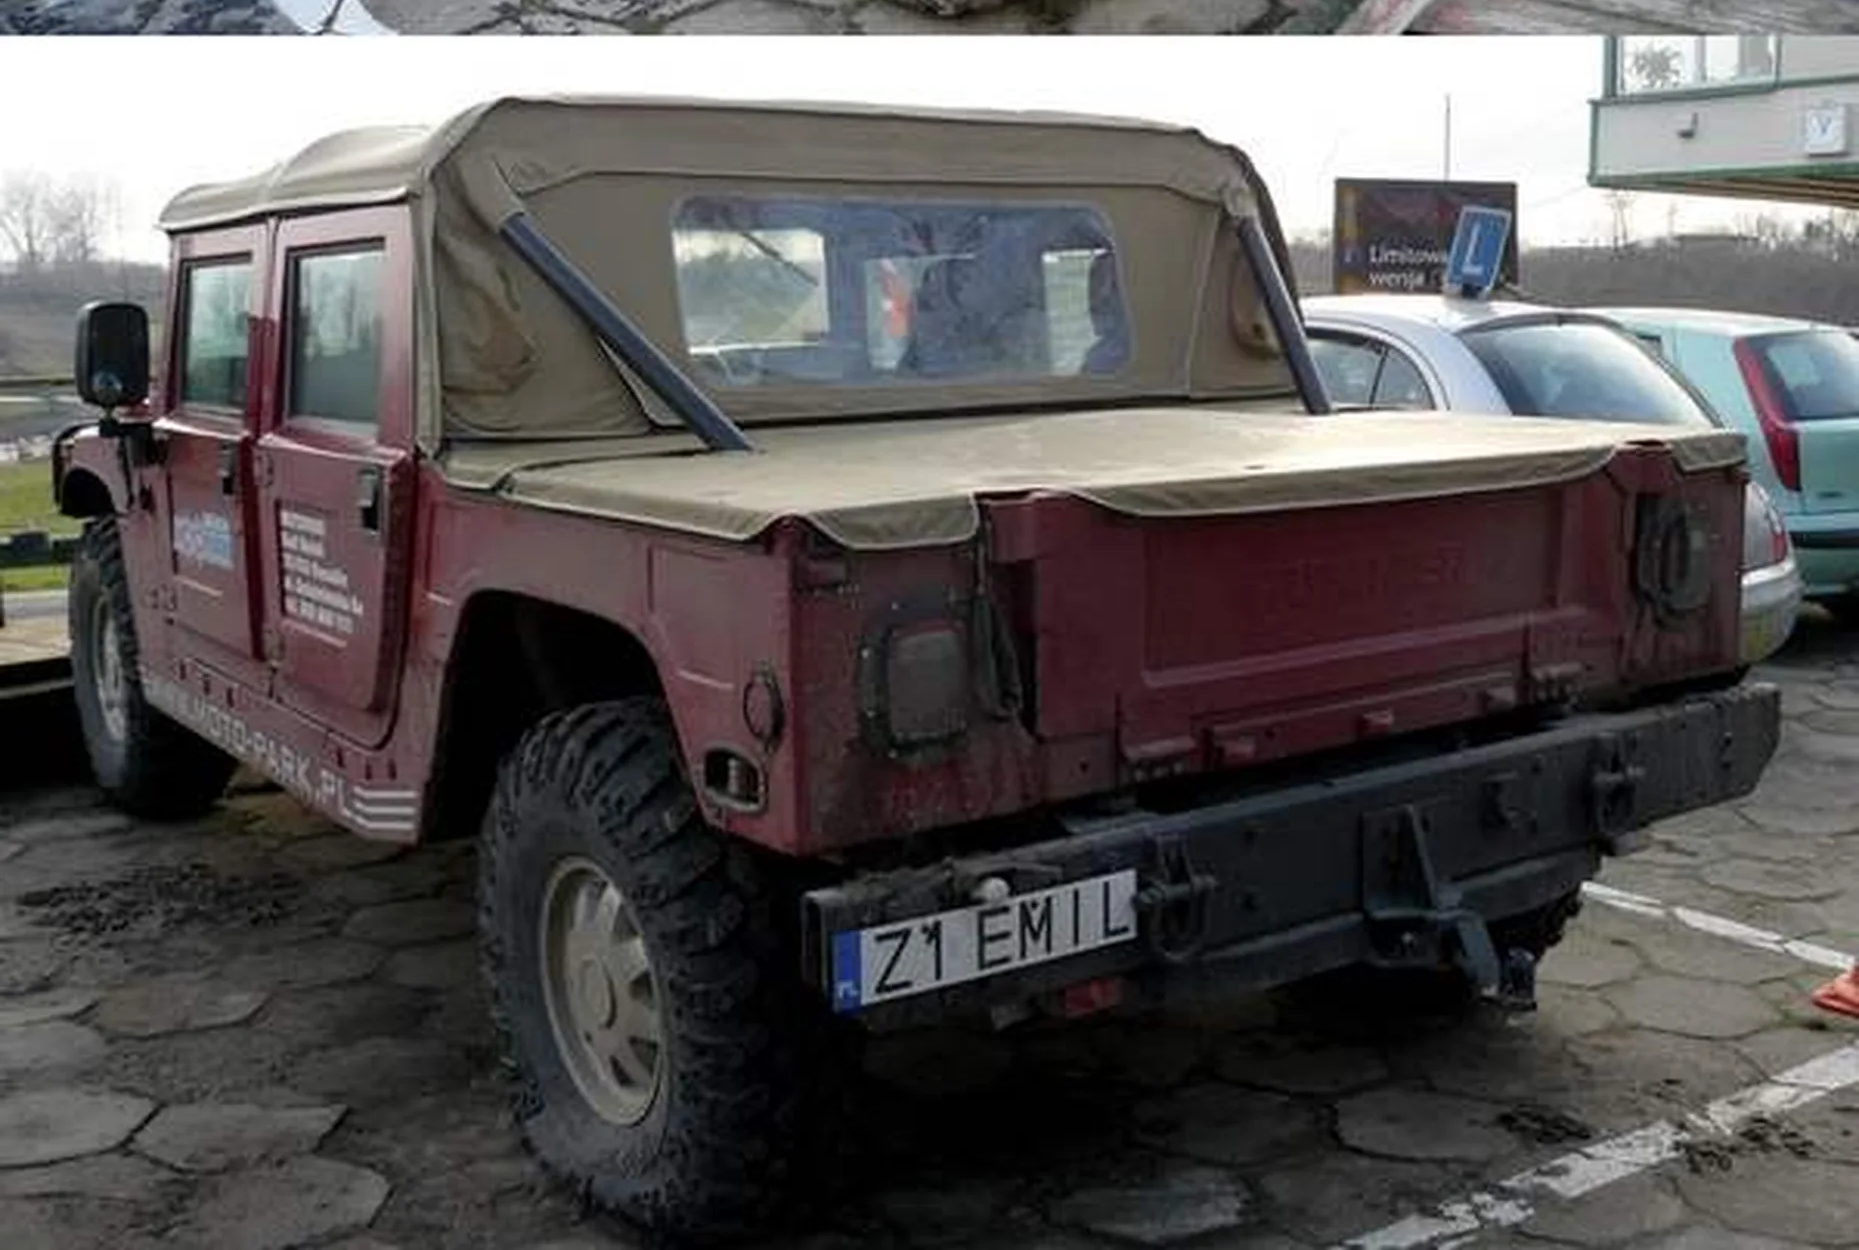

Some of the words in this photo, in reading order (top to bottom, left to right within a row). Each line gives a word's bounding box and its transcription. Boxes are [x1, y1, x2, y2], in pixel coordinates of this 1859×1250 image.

[1461, 221, 1484, 275] L
[874, 919, 942, 996] Z1
[977, 882, 1130, 971] EMIL
